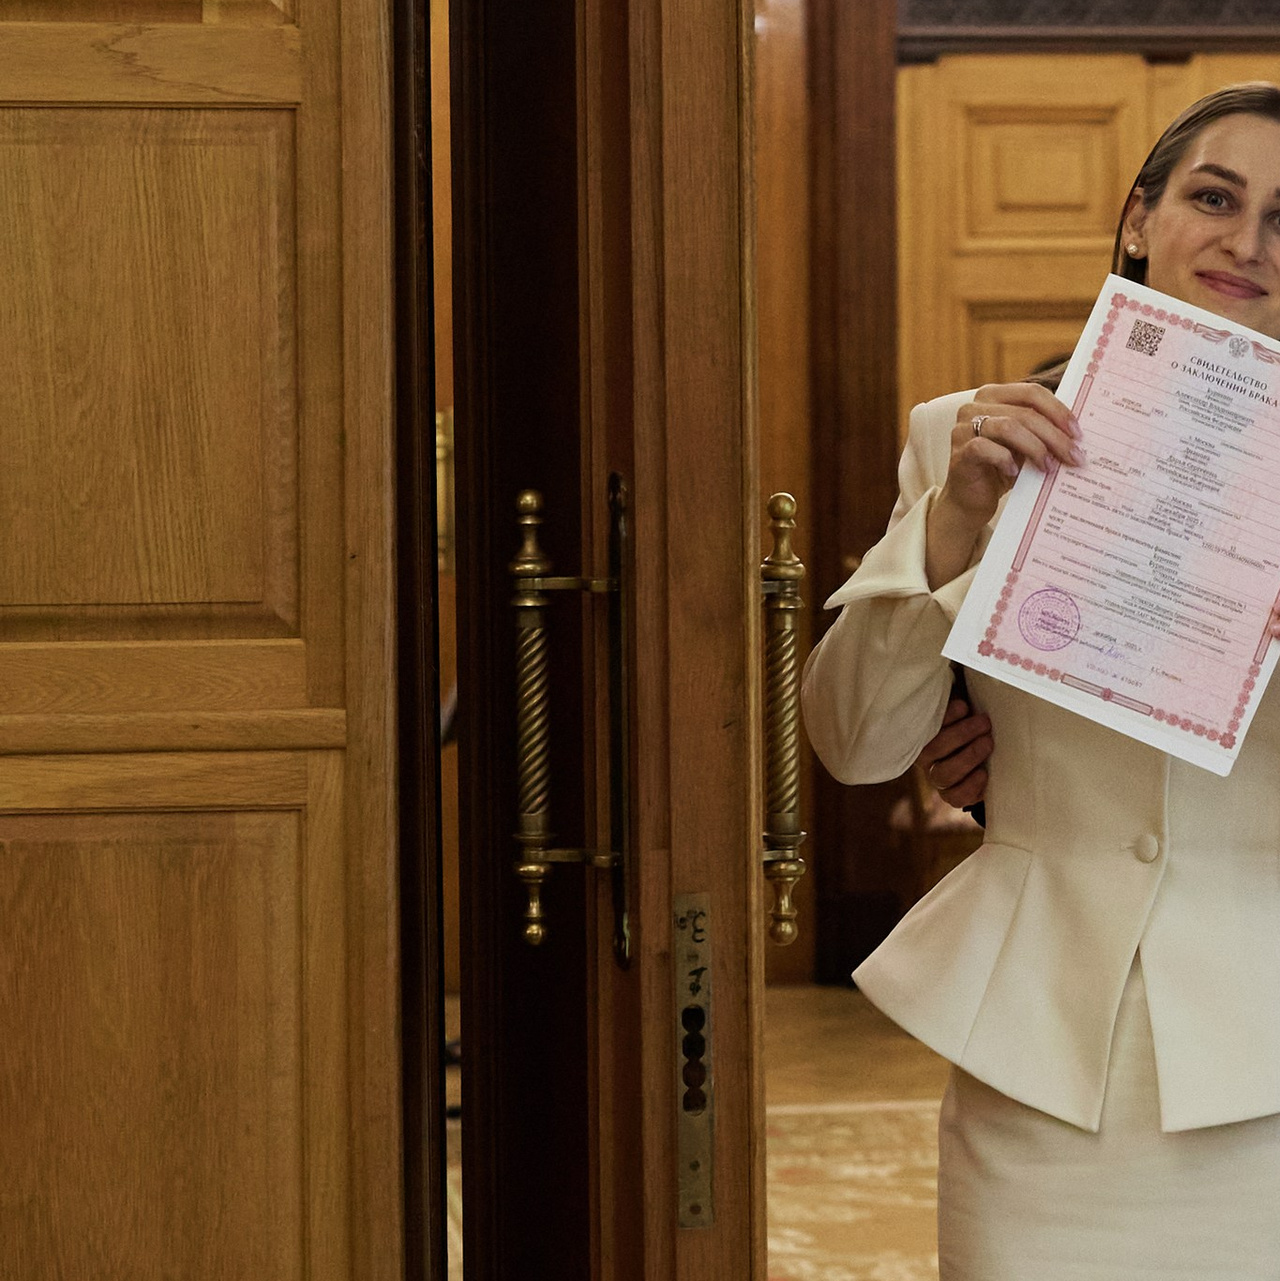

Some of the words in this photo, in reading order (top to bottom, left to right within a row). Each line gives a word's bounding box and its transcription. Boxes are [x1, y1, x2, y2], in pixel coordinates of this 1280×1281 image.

[1170, 360, 1179, 369] О
[1180, 364, 1247, 395] ЗАКЛЮЧЕНИИ
[1248, 390, 1279, 407] БРАКА
[1189, 355, 1268, 391] СВИДЕТЕЛЬСТВО
